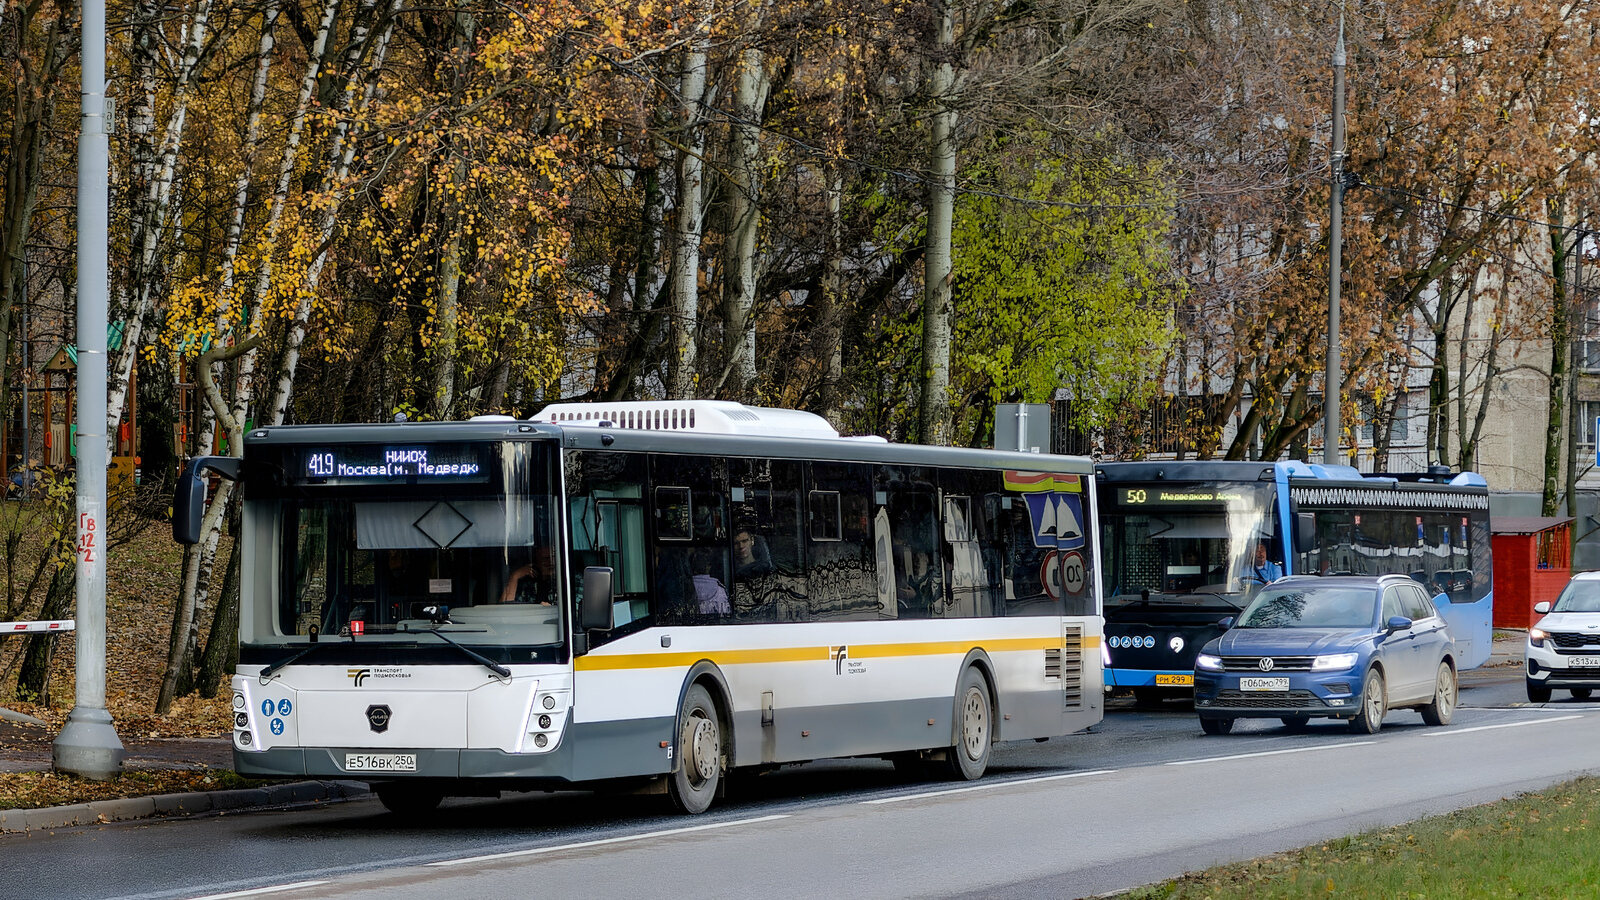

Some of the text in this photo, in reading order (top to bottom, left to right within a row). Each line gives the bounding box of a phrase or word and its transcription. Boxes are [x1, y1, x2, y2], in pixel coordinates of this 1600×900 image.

[386, 450, 427, 463] НИИОХ
[309, 453, 334, 475] 419
[1126, 489, 1147, 503] 50
[1160, 492, 1213, 501] Медведково
[80, 532, 95, 547] 12
[83, 548, 94, 562] 2
[395, 755, 412, 765] 250
